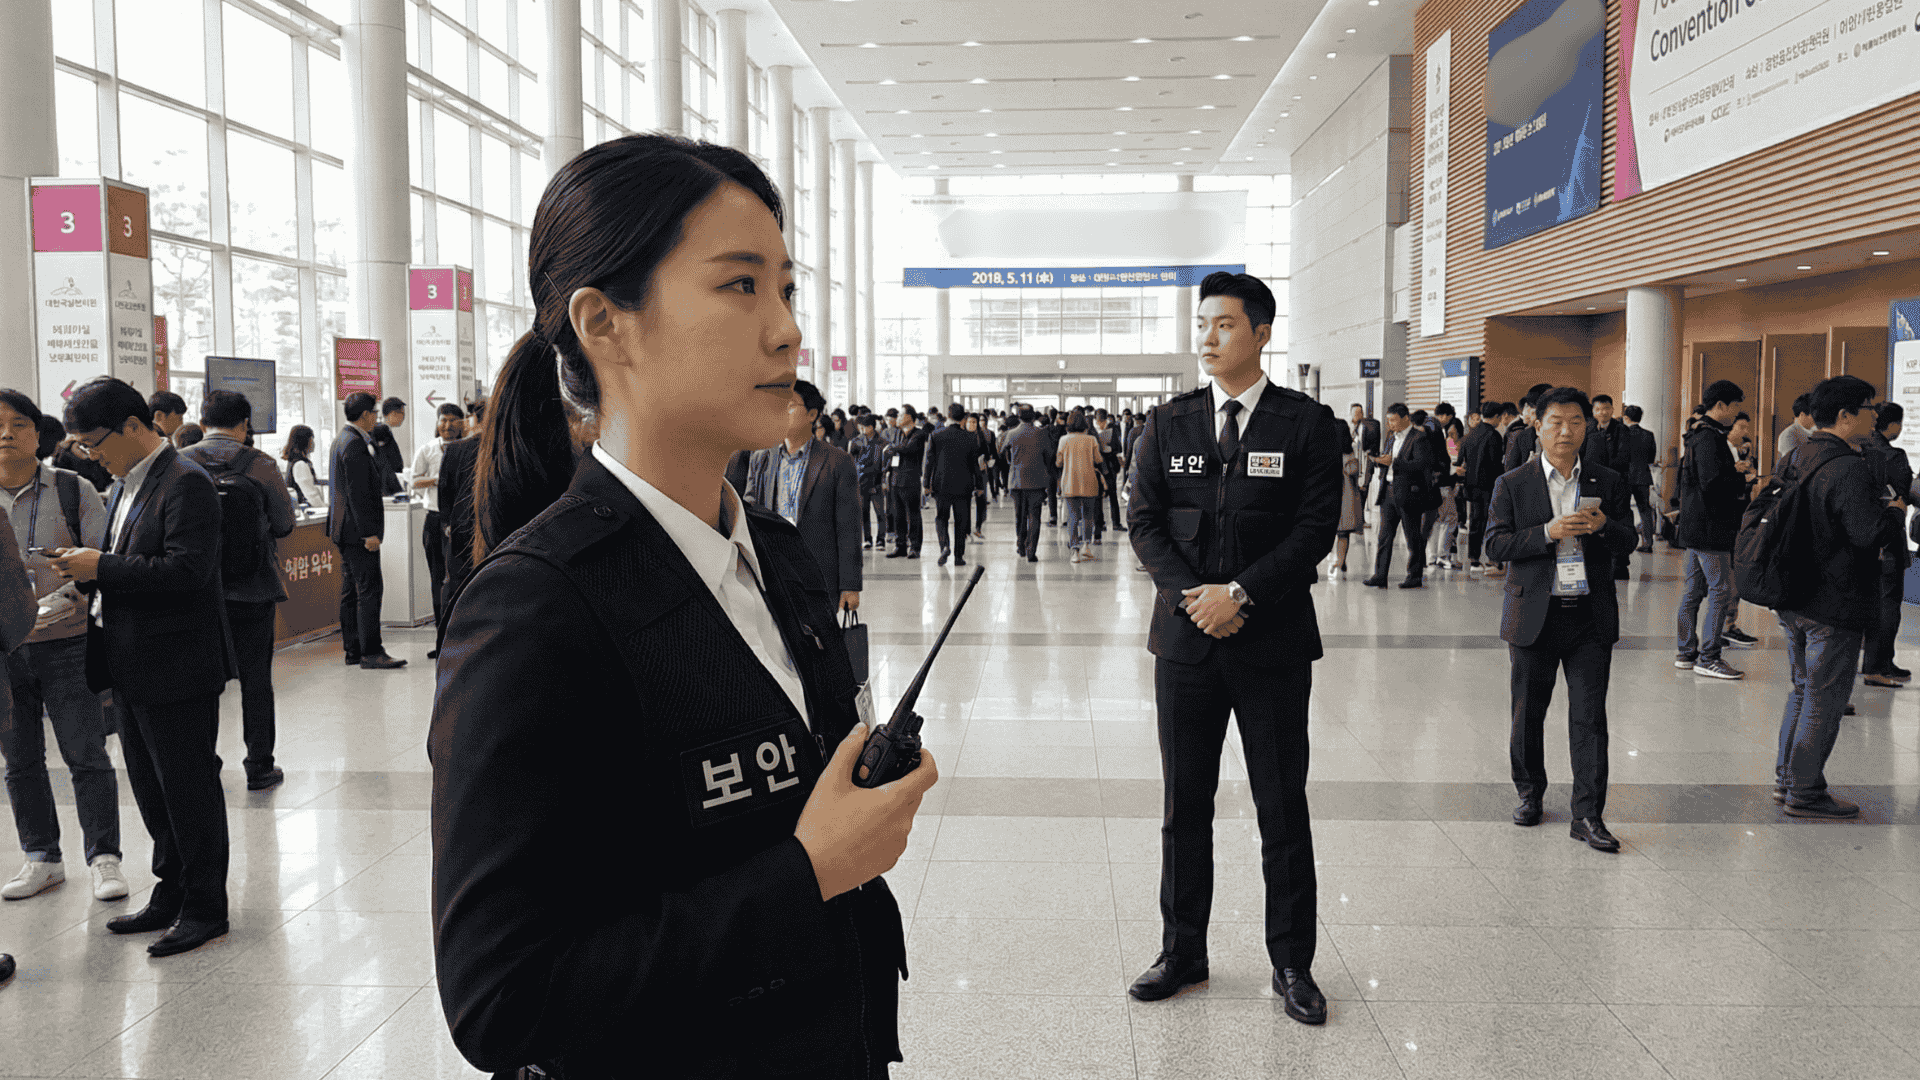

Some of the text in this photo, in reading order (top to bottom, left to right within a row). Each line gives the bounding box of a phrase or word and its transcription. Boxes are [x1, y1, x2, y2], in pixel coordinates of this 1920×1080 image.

[1651, 0, 1739, 61] Convention
[60, 211, 75, 234] 3
[123, 215, 132, 238] 3
[1020, 271, 1033, 285] 11
[427, 284, 438, 299] 3
[1169, 455, 1205, 474] 보안
[702, 733, 800, 810] 보안
